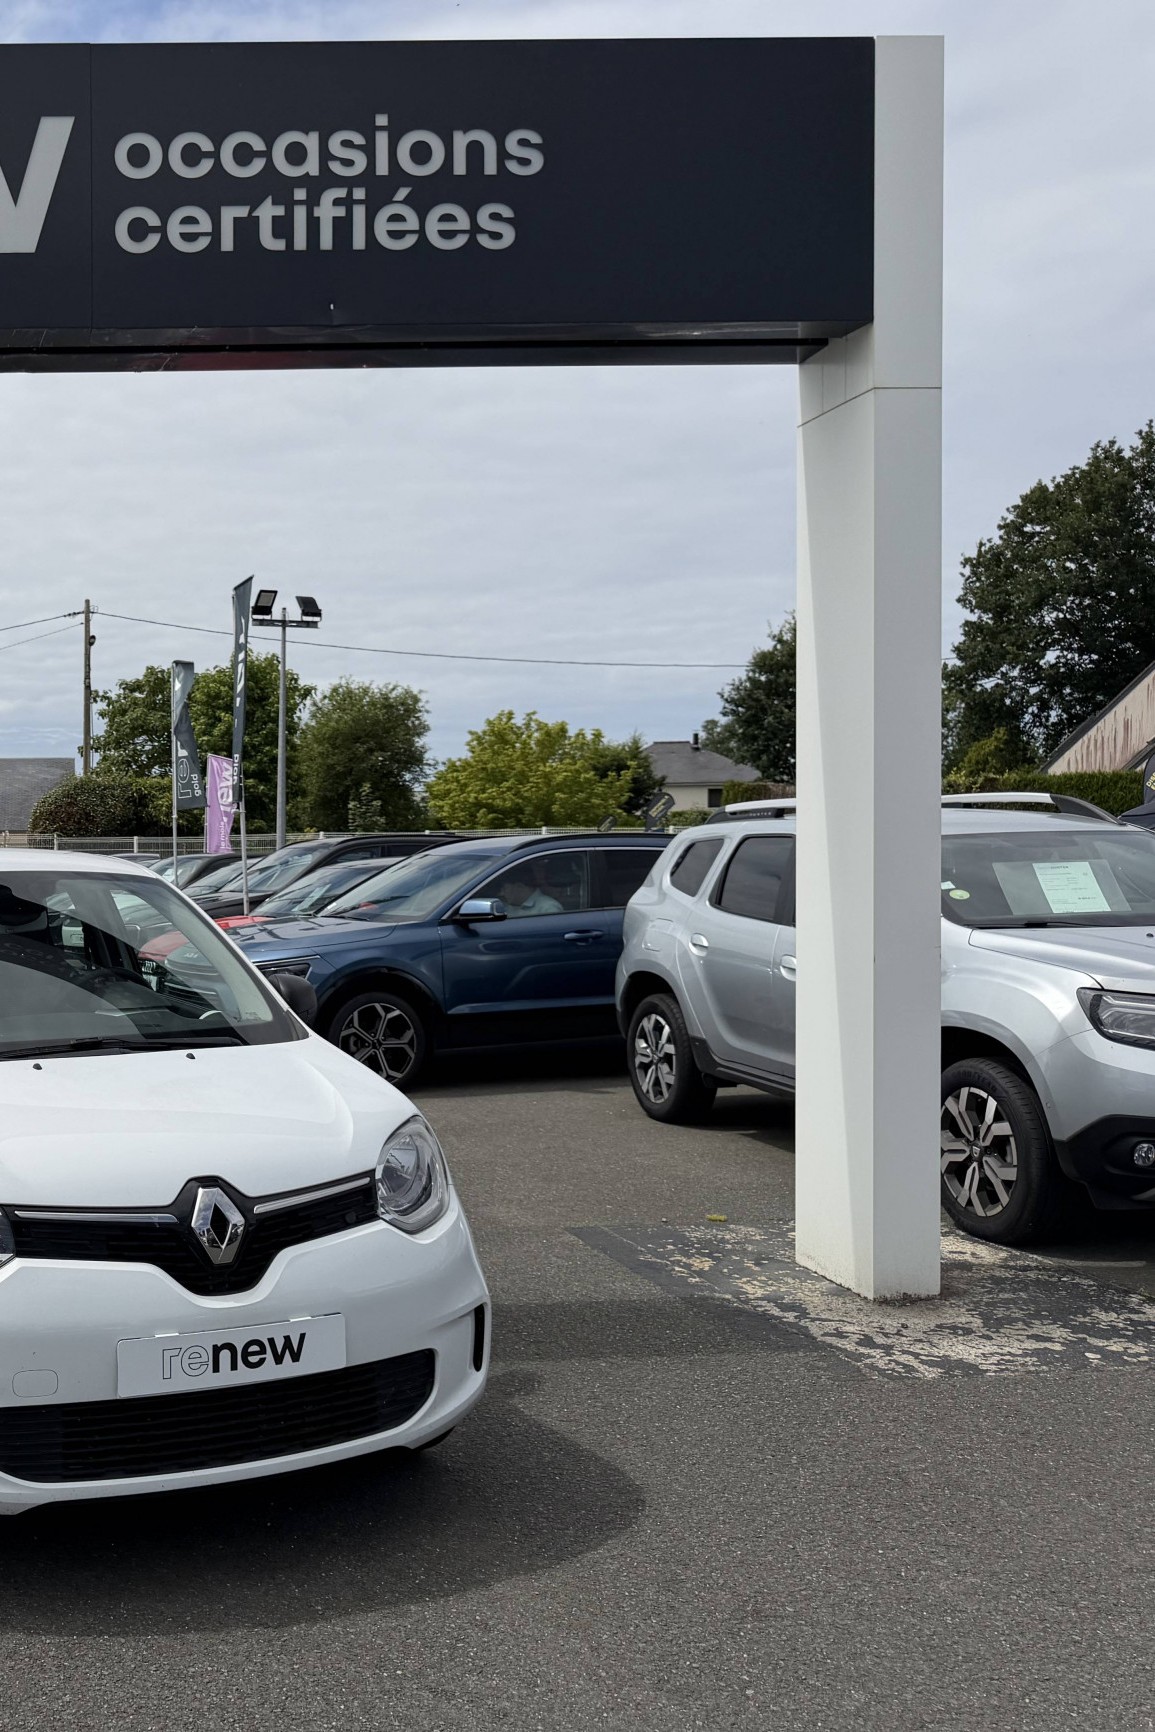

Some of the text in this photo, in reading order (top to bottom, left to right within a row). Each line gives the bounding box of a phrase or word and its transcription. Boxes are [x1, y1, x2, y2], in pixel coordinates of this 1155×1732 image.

[114, 113, 545, 180] occasions
[114, 186, 517, 254] certifiées
[162, 1332, 306, 1380] renew
